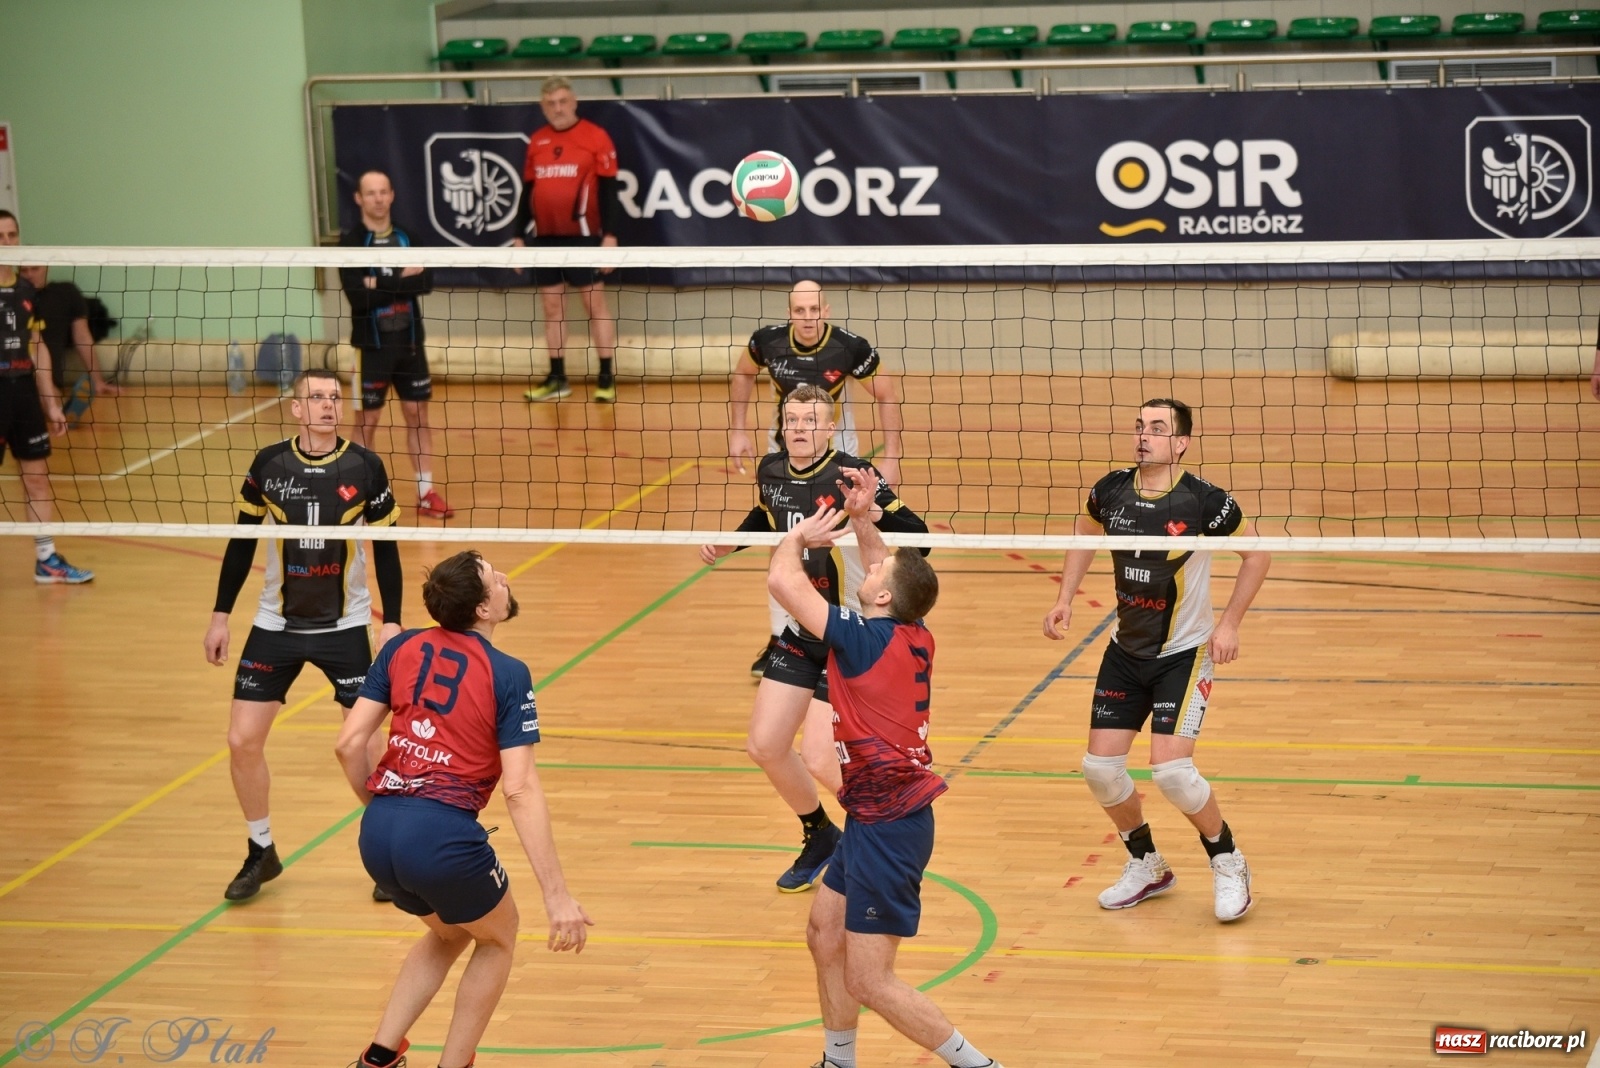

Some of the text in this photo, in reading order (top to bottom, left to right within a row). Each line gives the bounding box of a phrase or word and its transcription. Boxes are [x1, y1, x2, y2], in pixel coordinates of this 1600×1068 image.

[616, 149, 941, 219] RACÓRZ
[1179, 209, 1304, 235] RACIBÓRZ
[300, 538, 325, 549] ENTER
[1125, 566, 1151, 583] ENTER
[412, 641, 469, 716] 13
[908, 646, 931, 712] 3
